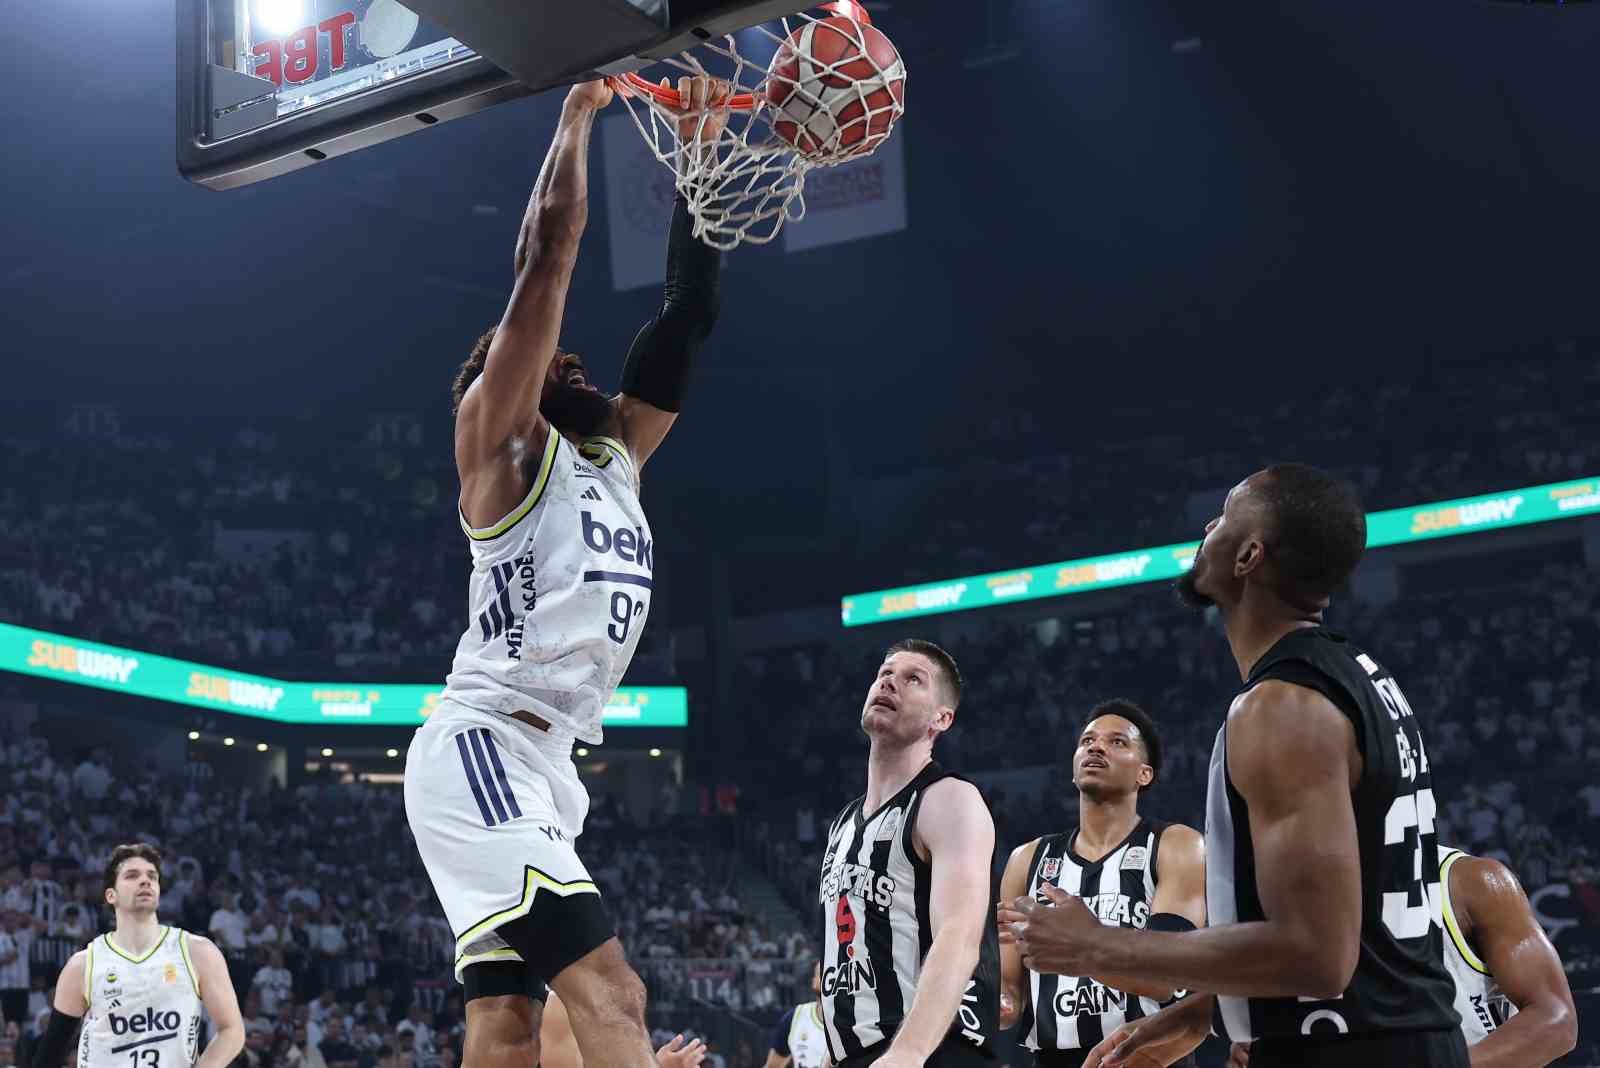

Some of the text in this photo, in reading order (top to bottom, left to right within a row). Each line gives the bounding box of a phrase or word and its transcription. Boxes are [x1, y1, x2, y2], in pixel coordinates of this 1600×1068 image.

[28, 640, 138, 683] SUBWAY
[821, 958, 878, 998] GAIN
[1054, 981, 1128, 1018] GAIN
[108, 1007, 181, 1035] beko
[129, 1048, 160, 1068] 13
